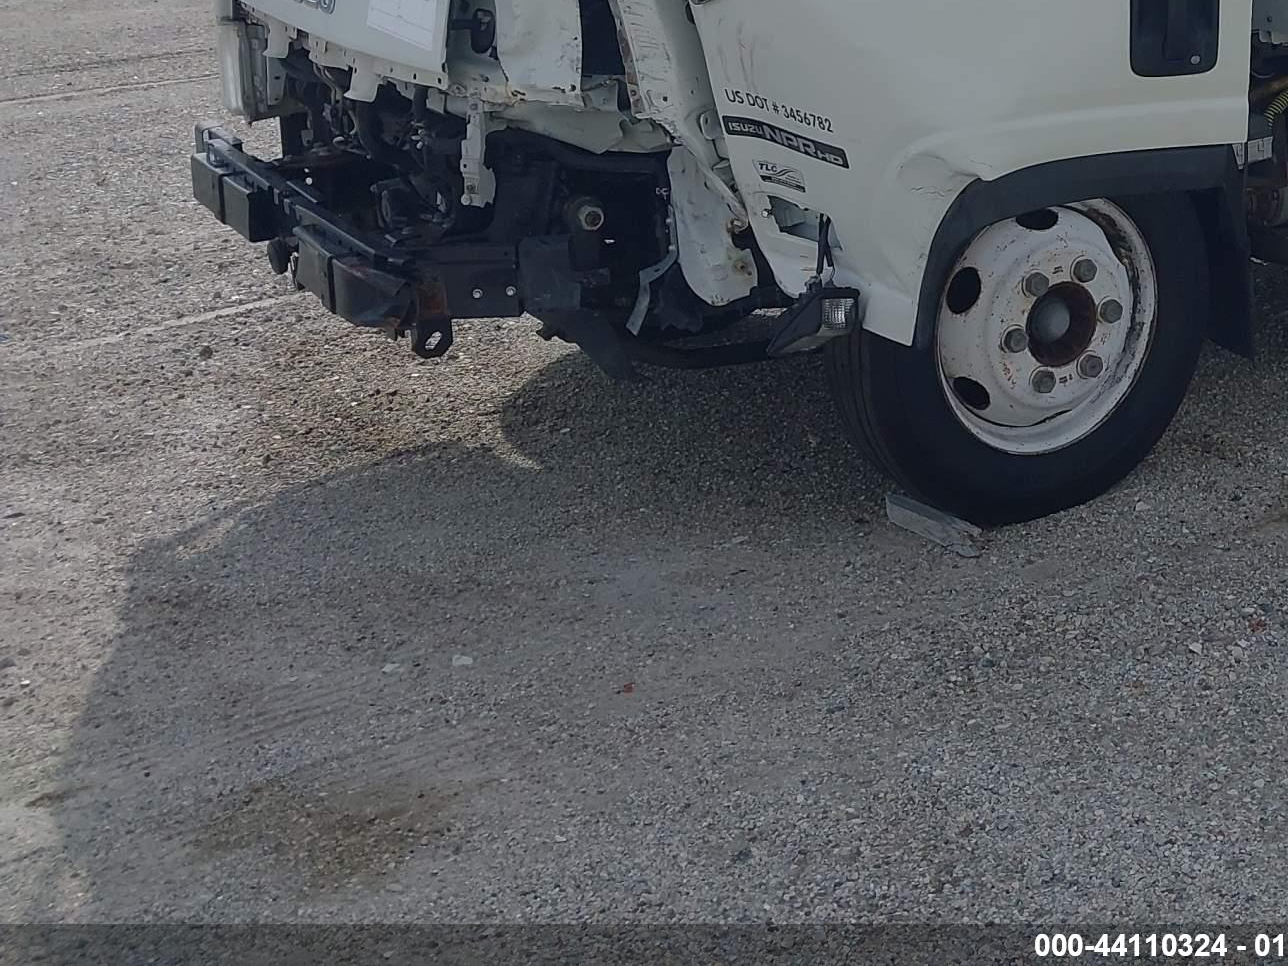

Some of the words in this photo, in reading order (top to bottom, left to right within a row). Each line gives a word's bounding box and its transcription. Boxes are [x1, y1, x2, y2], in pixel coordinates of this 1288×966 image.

[724, 88, 745, 104] US
[746, 92, 770, 113] DOT
[772, 101, 780, 115] #
[781, 105, 834, 133] 3456782
[728, 121, 763, 135] ISUZU
[763, 125, 816, 158] NPR
[816, 150, 844, 166] HD
[758, 162, 778, 173] TLC
